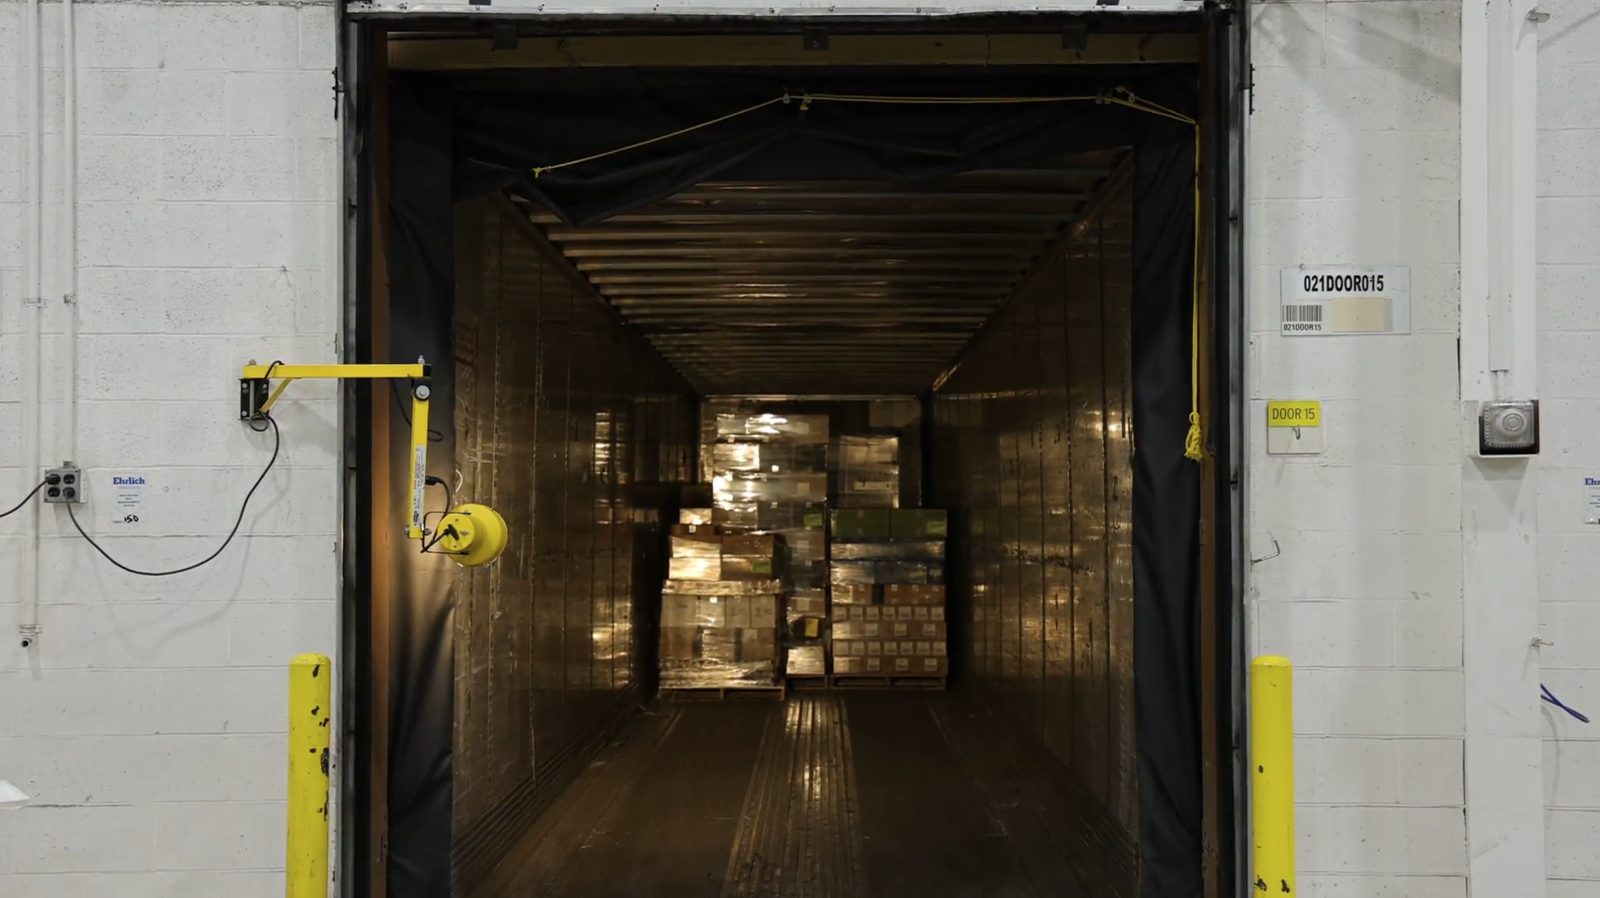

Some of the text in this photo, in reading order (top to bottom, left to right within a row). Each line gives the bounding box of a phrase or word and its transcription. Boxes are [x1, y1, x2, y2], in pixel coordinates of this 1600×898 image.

[1303, 275, 1384, 292] 021DOOR015
[1283, 323, 1322, 331] 021DOOR15
[1272, 407, 1315, 420] DOOR 15
[112, 476, 145, 485] Ehrlich
